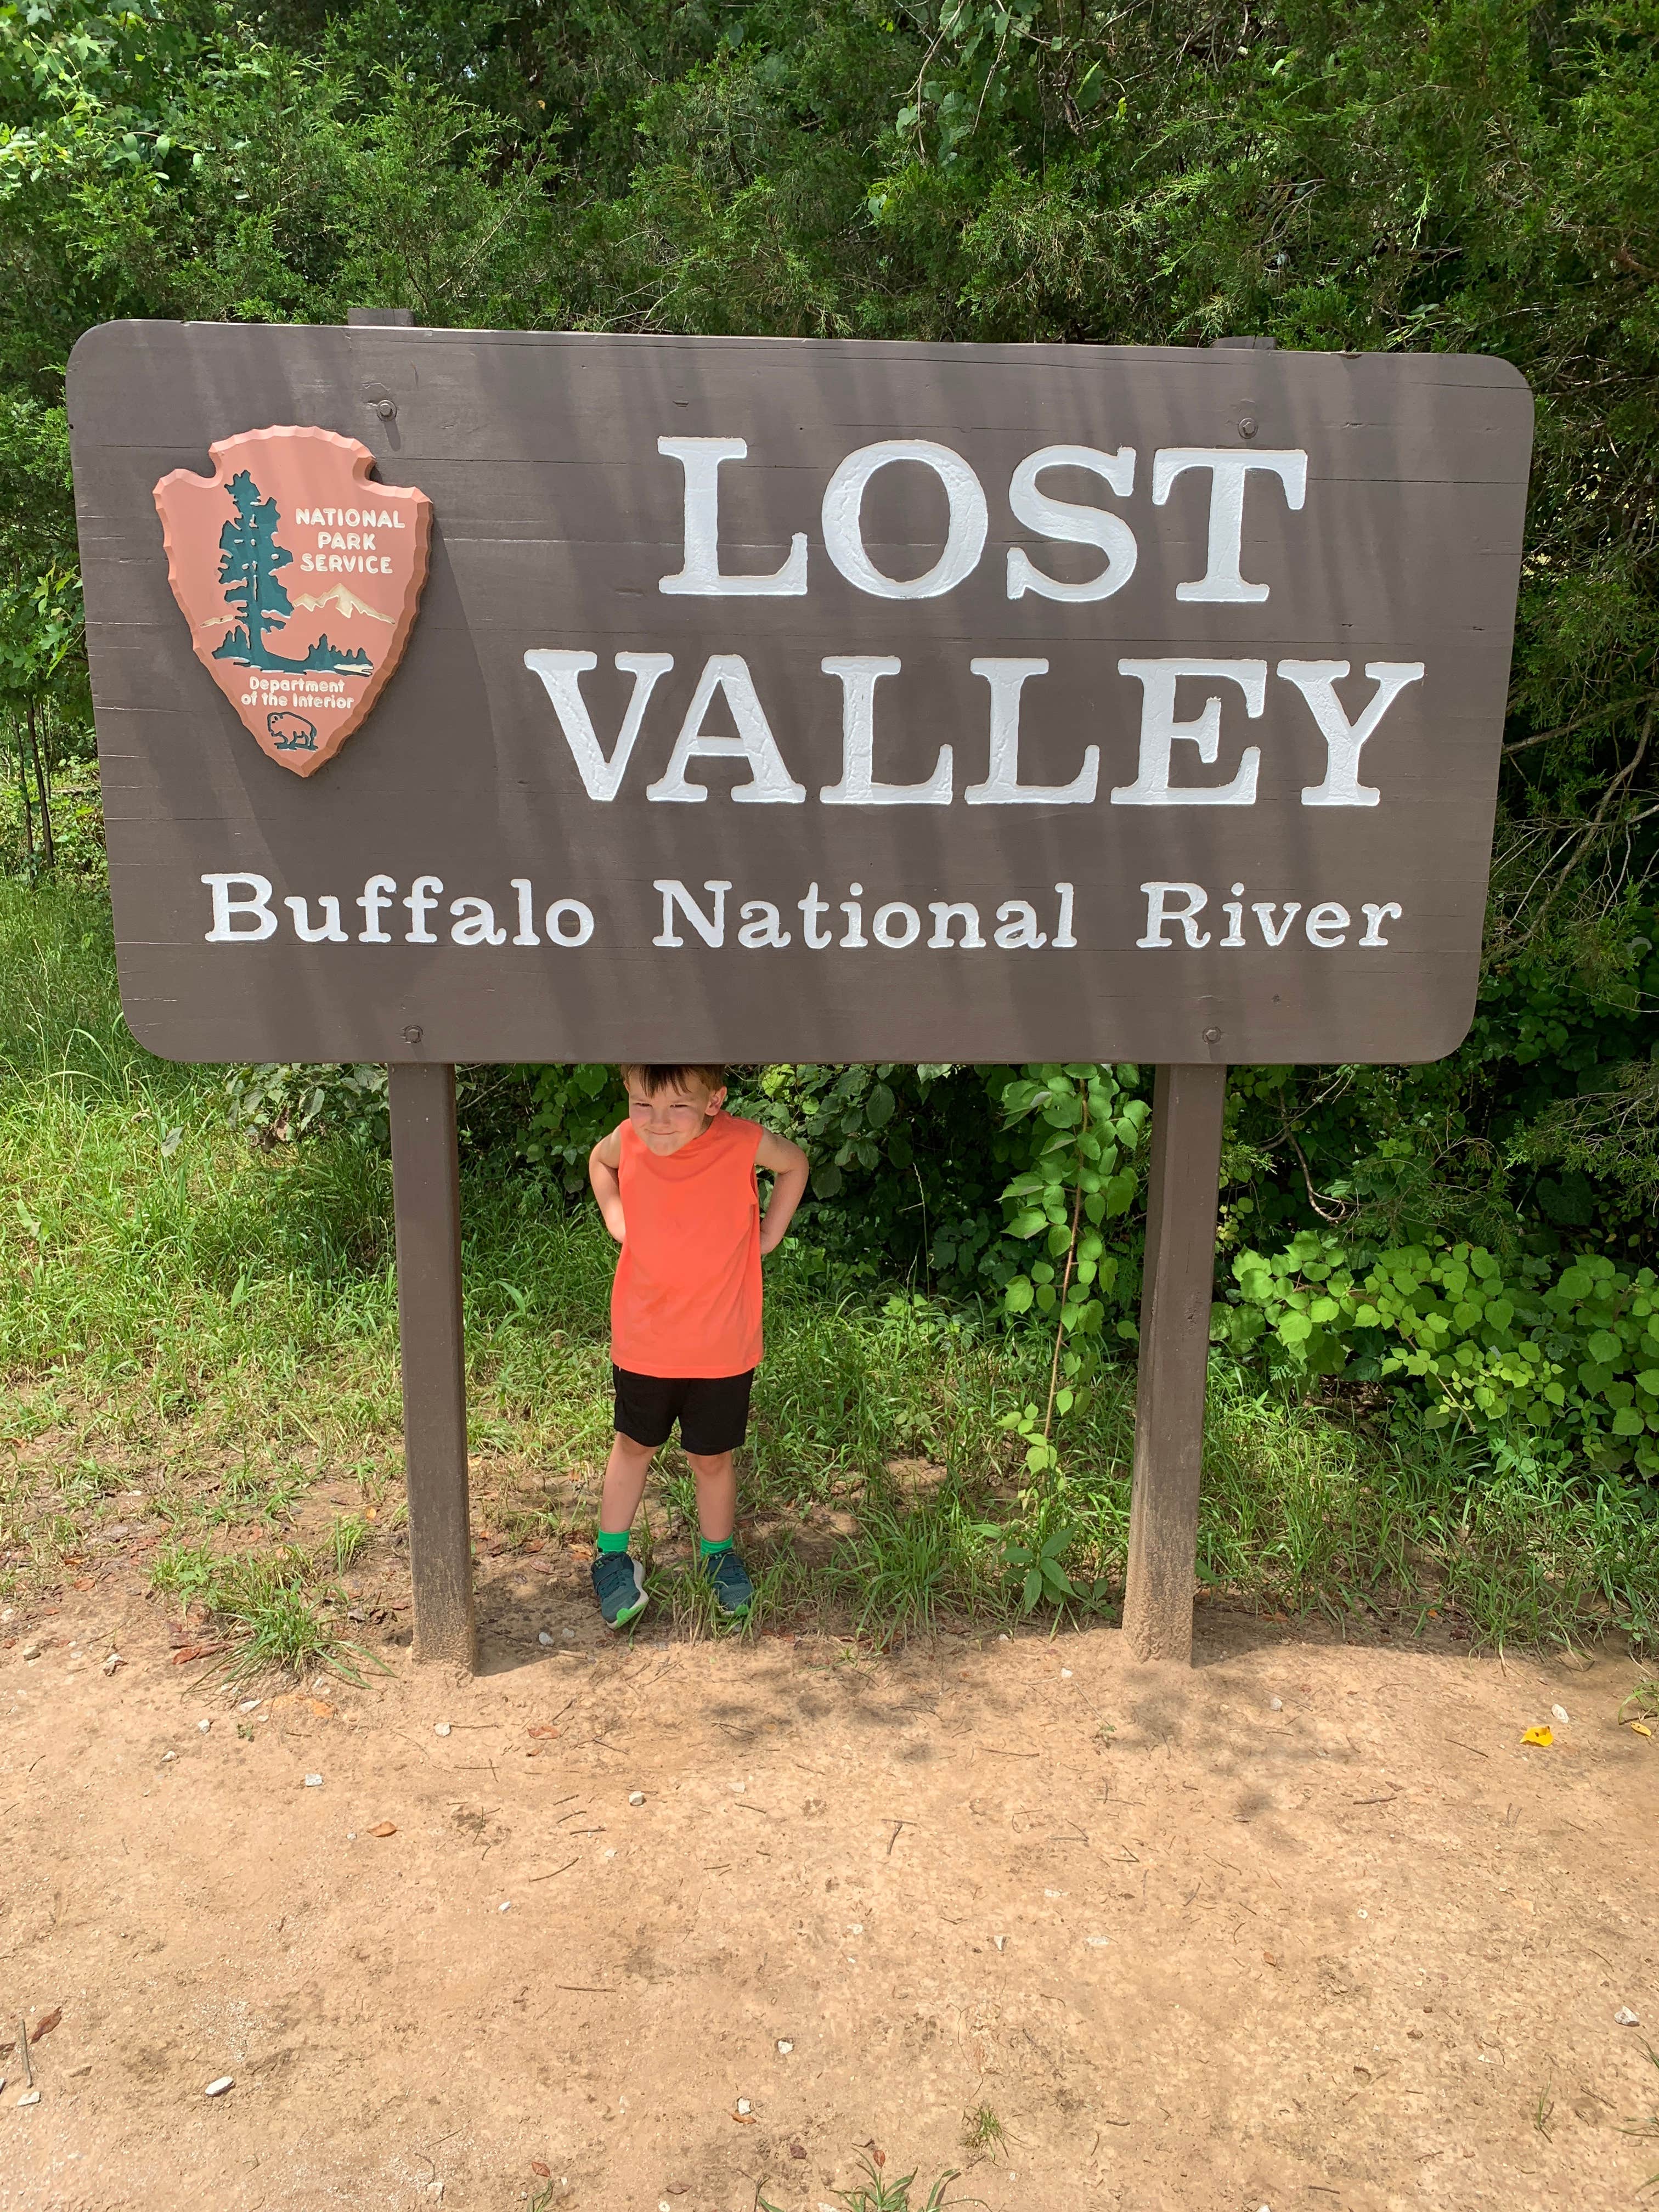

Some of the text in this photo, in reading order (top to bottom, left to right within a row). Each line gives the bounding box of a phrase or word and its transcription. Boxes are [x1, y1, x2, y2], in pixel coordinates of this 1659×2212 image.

[296, 508, 405, 528] NATIONAL
[656, 435, 1309, 603] LOST
[318, 532, 376, 550] PARK
[300, 553, 393, 573] SERVICE
[250, 676, 345, 693] Department
[241, 691, 354, 708] of the Interior
[523, 647, 1426, 808] VALLEY
[200, 871, 1404, 950] Buffalo National River
